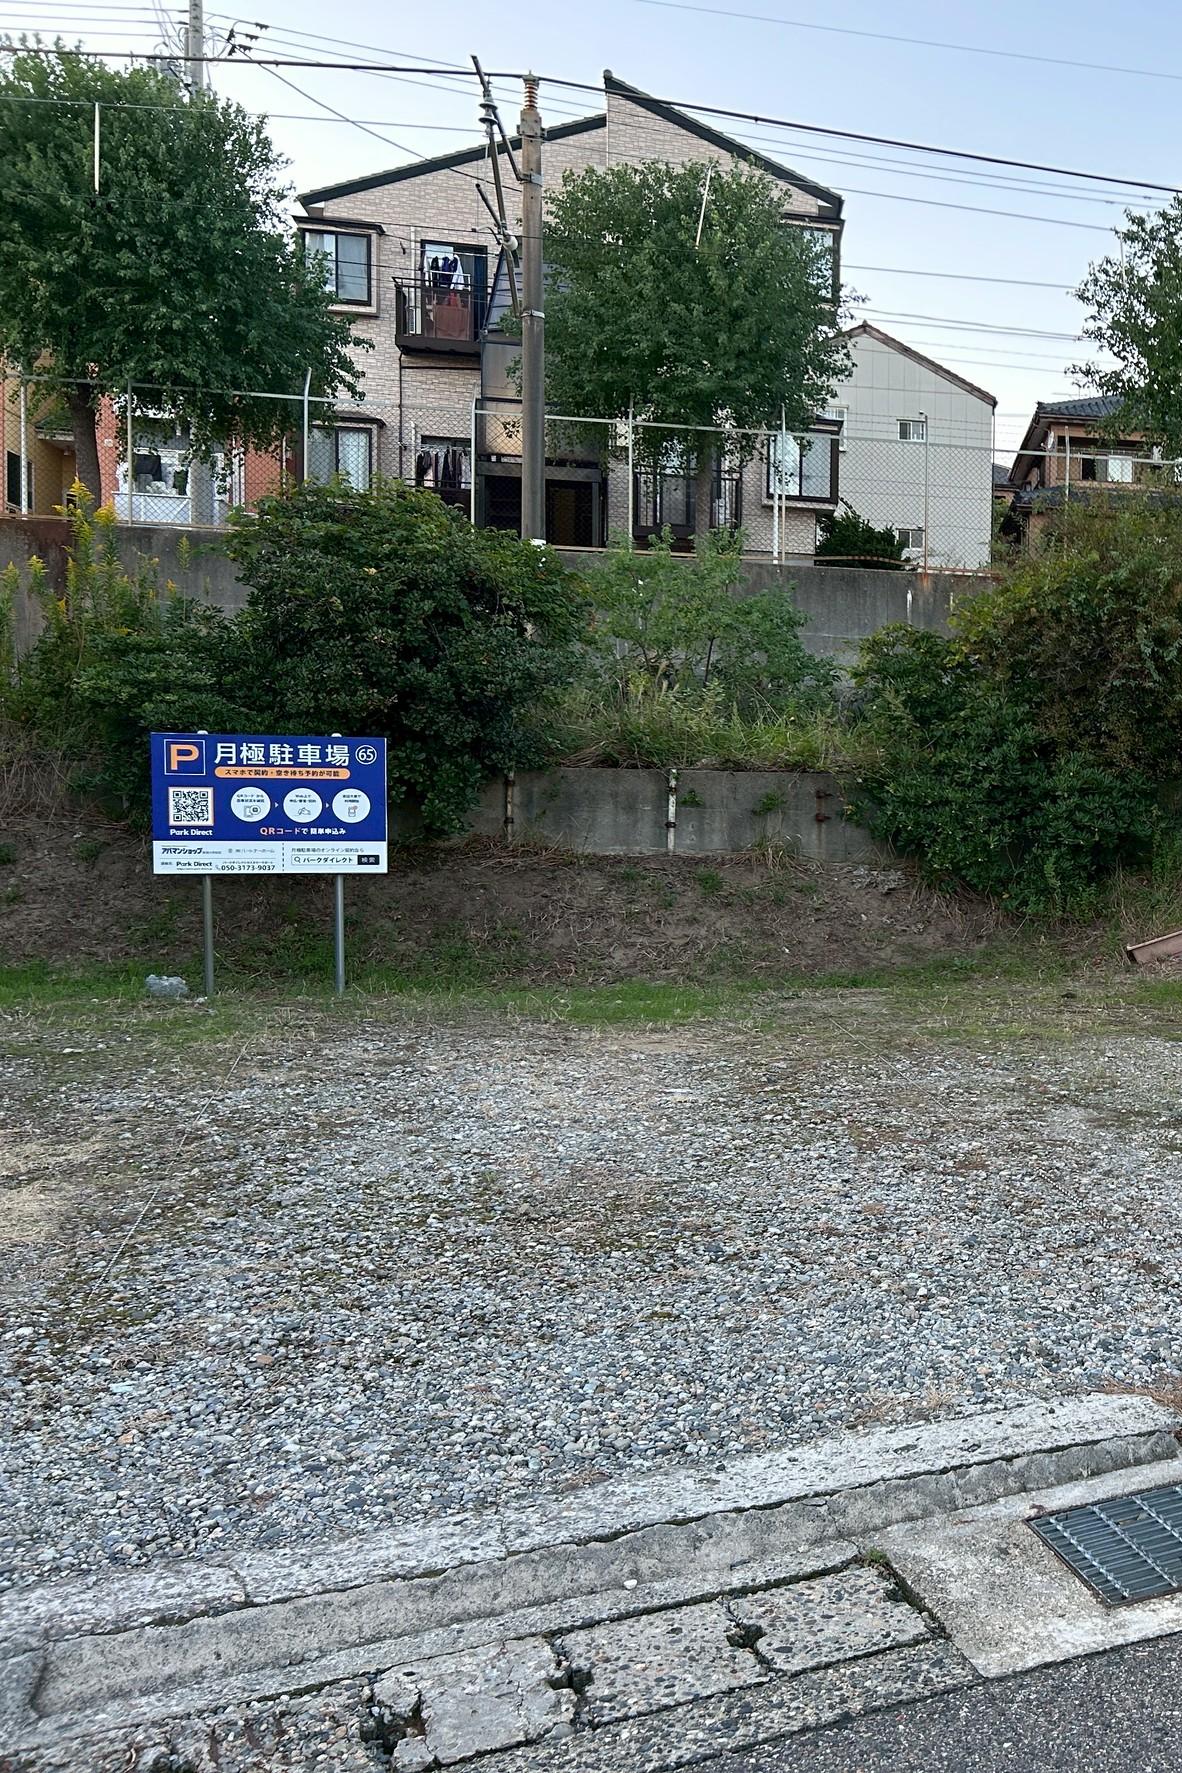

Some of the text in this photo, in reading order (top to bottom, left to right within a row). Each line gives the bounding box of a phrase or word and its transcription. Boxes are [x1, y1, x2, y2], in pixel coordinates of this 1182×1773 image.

[170, 744, 199, 770] P
[214, 743, 350, 766] 月極駐車場
[170, 828, 213, 836] Park Direct
